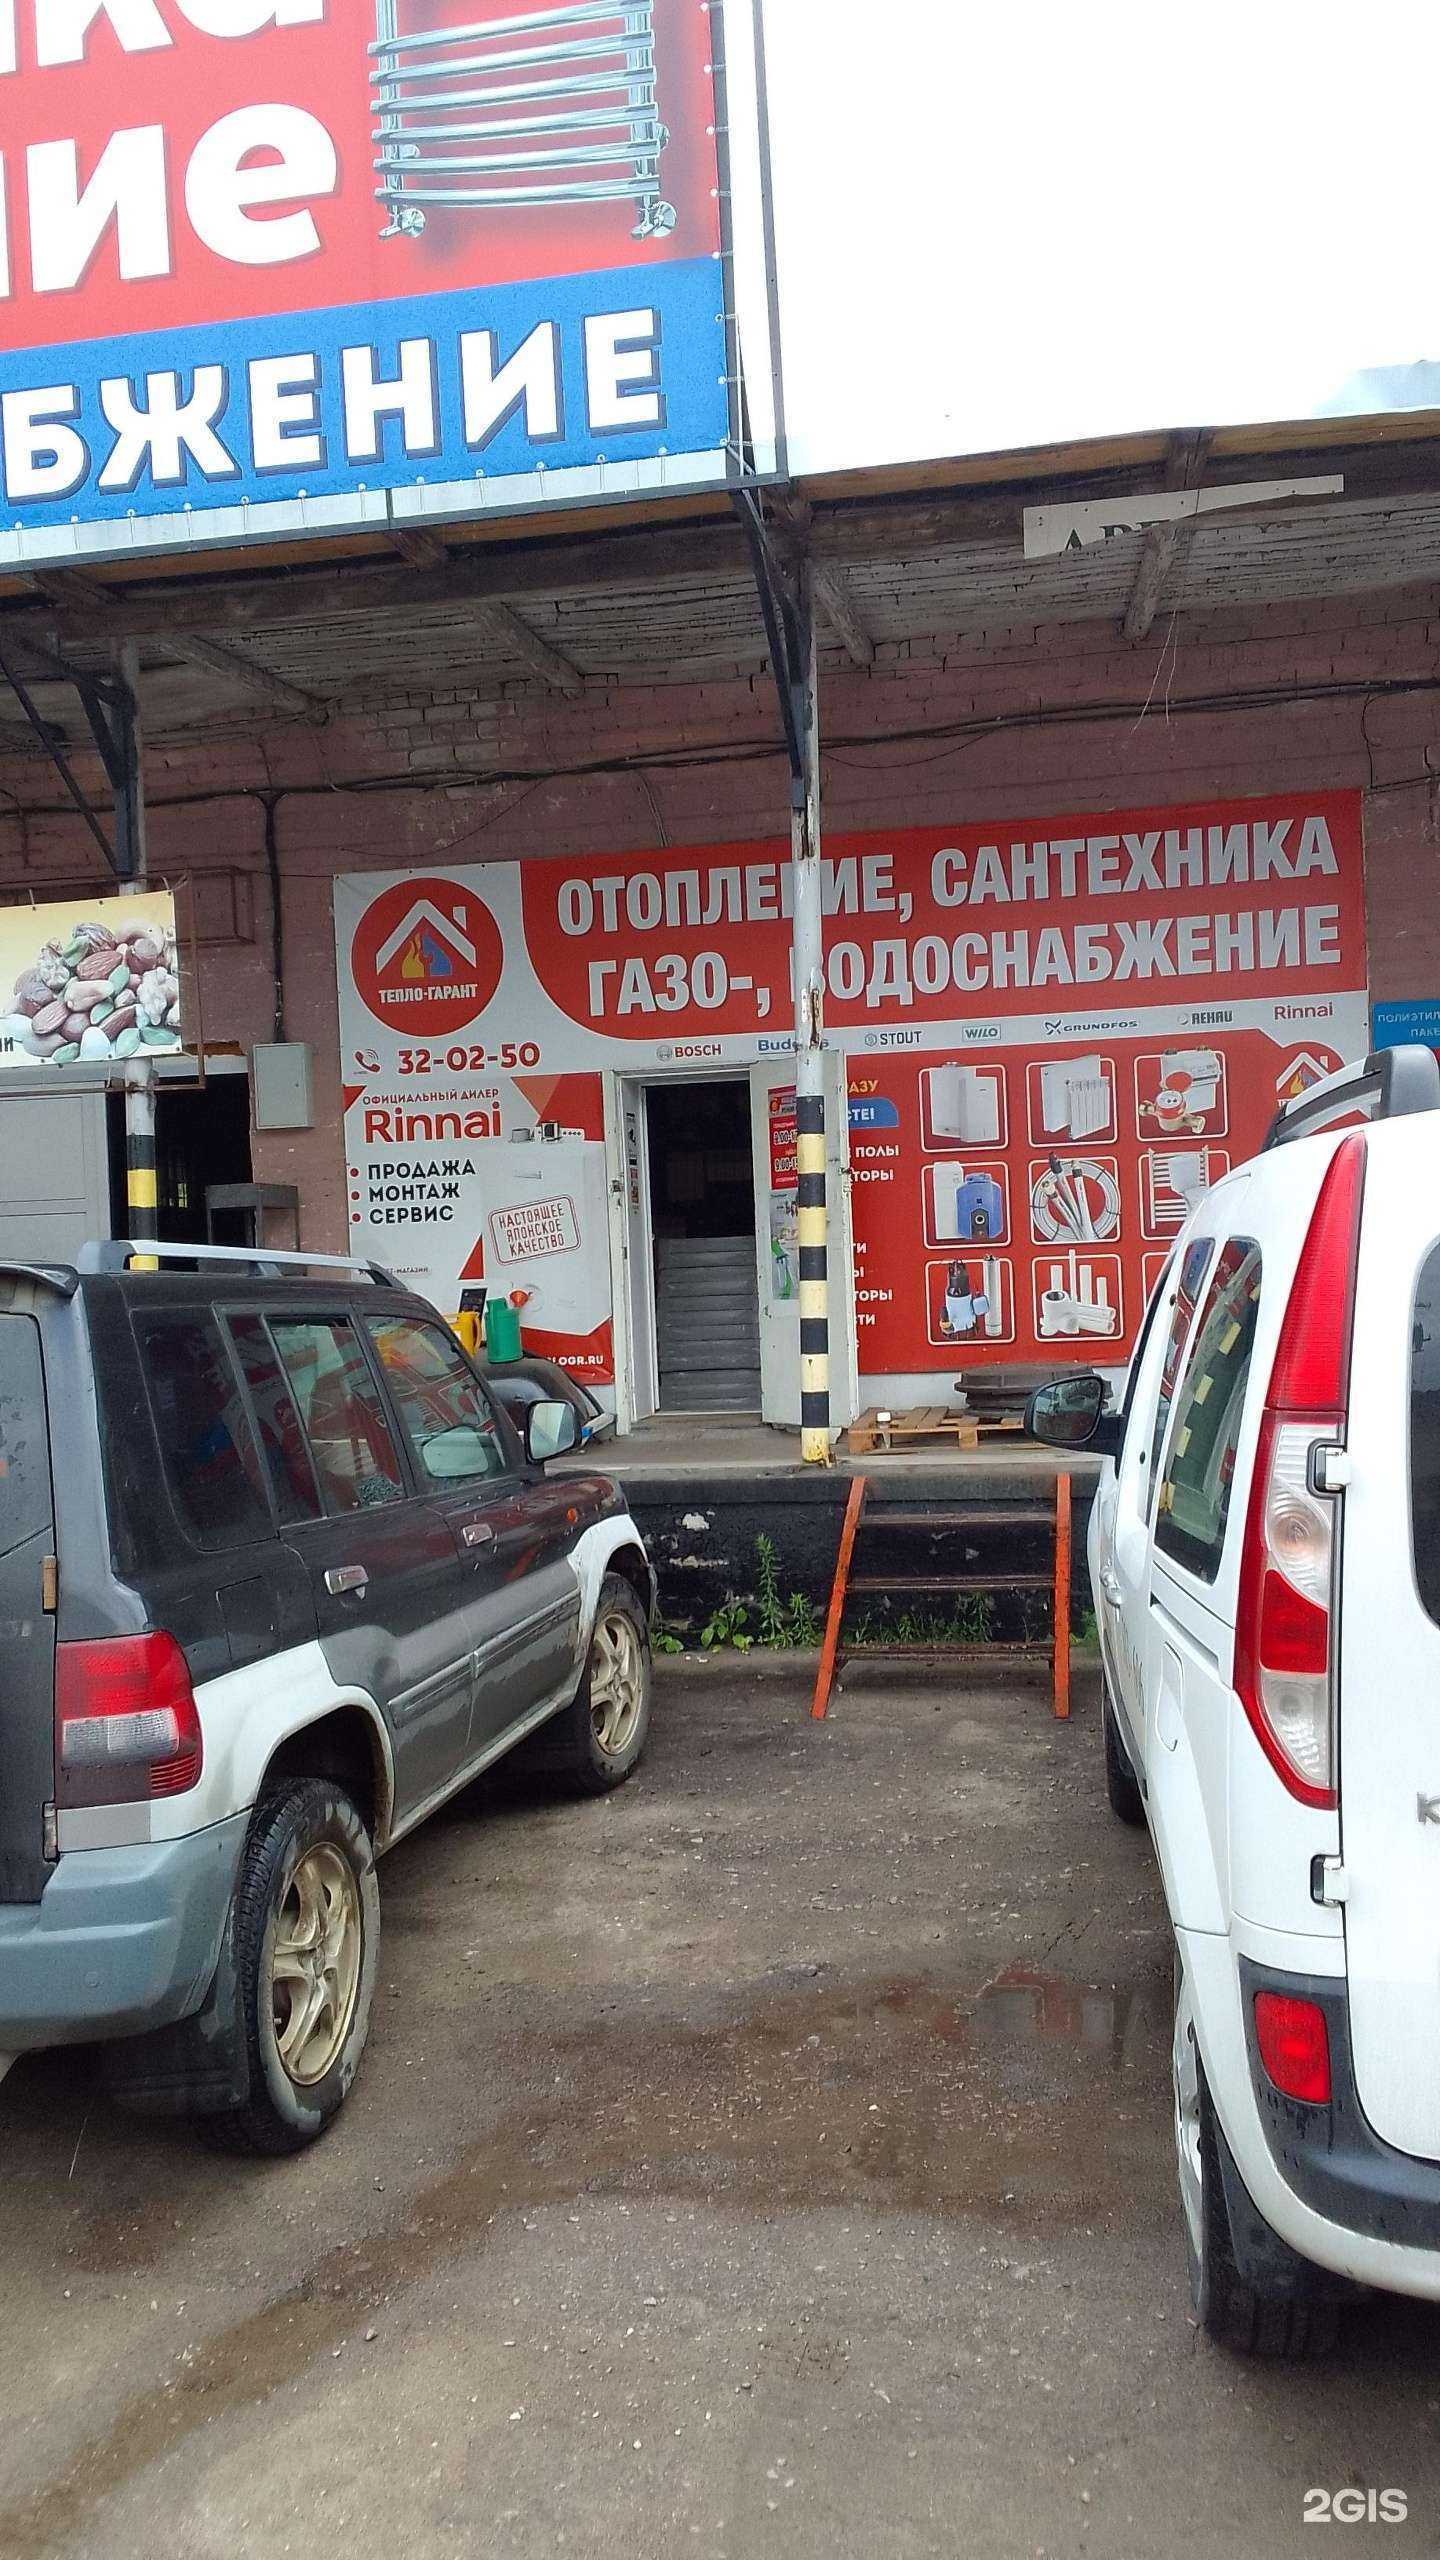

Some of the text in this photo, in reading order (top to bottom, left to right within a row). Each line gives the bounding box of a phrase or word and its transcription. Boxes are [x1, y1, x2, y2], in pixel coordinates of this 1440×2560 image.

[0, 103, 338, 297] ие
[1, 307, 665, 500] БЖЕНИЕ
[931, 816, 1340, 908] САНТЕХНИКА
[588, 905, 1342, 1017] ГАЗО-, ОДОСНАБЖЕНИЕ
[378, 984, 478, 1003] ТЕПЛО-ГАРАНТ
[675, 1002, 1333, 1057] BOSCH Buds STOUT WILO GRUNDFOS REHAU Rinnai
[398, 1042, 541, 1074] 32-02-50
[363, 1088, 499, 1105] ОФИЦИАЛЬНЫЙ ДИЛЕР
[847, 1080, 878, 1093] АЗУ
[364, 1101, 501, 1143] Rinnai
[855, 1145, 899, 1158] ПОЛЫ
[368, 1159, 475, 1180] ПРОДАЖА
[369, 1182, 460, 1202] МОНТАЖ
[369, 1205, 454, 1225] СЕРВИС
[499, 1203, 564, 1228] НАСТОЯЩЕЕ
[506, 1219, 562, 1242] ЯПОНСКОЕ
[509, 1234, 564, 1257] КАЧЕСТВО
[853, 1289, 893, 1301] ТОРЫ
